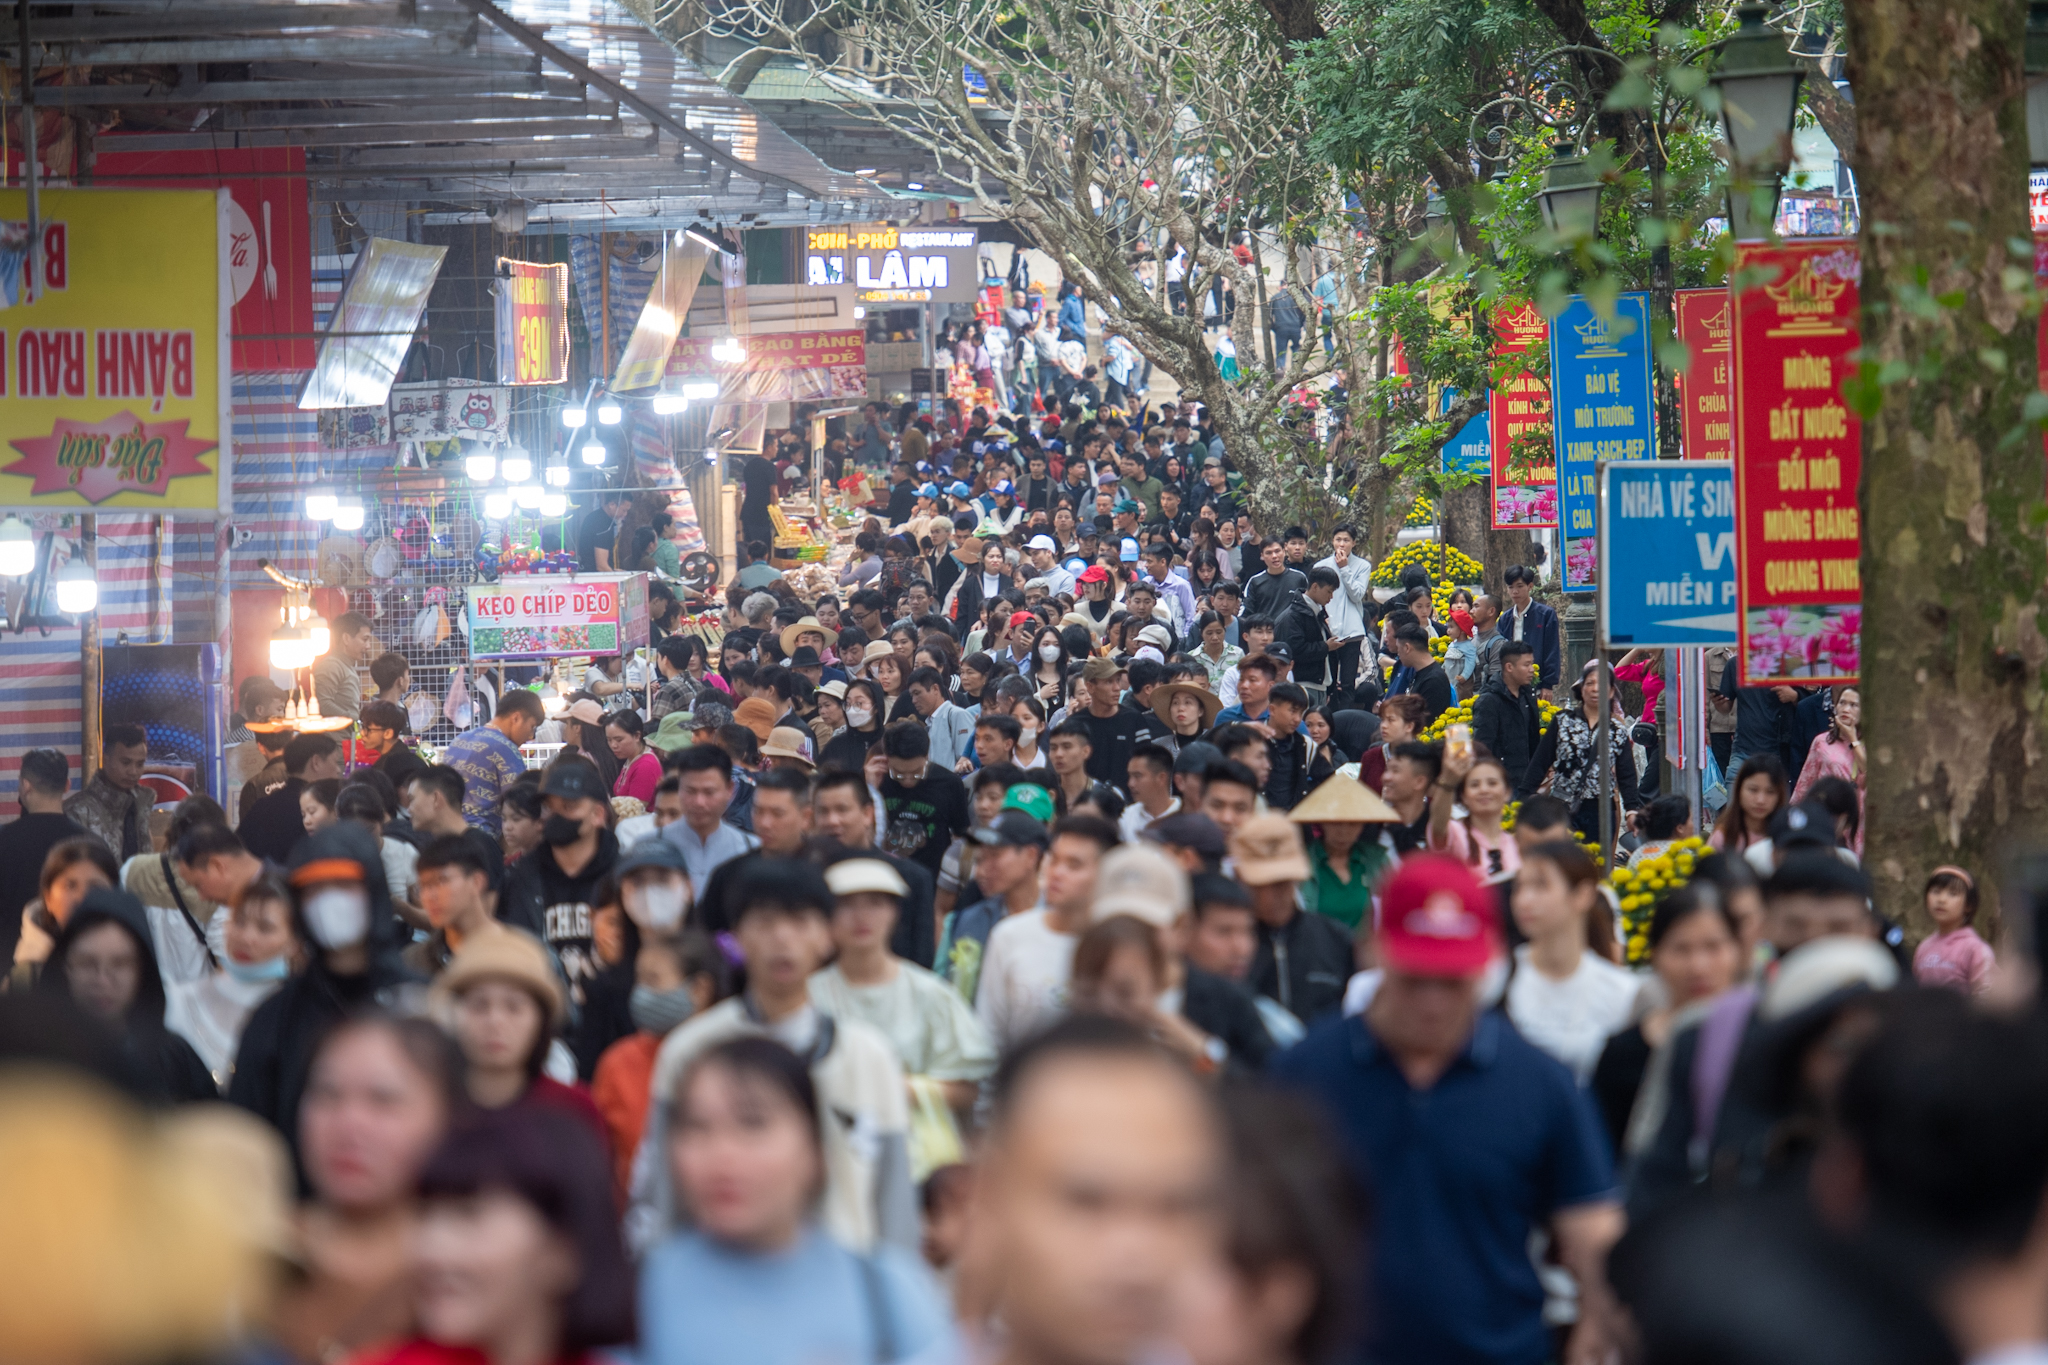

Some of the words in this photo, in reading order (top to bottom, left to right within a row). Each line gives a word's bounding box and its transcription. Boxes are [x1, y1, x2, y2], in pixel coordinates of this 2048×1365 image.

[900, 232, 975, 247] RESTAURANT
[856, 249, 948, 288] LÂM
[751, 338, 794, 352] CAO
[801, 333, 862, 349] BẰNG
[820, 349, 858, 365] DẺ
[18, 330, 85, 397] RAU
[96, 331, 193, 413] BÁNH
[1586, 365, 1605, 394] BẢO
[1608, 368, 1621, 397] VỆ
[1783, 349, 1832, 390] MỪNG
[1508, 398, 1528, 415] KÍNH
[1575, 404, 1594, 429] MÔI
[1596, 402, 1635, 427] TRƯỜNG
[1699, 392, 1727, 413] CHÙA
[1769, 397, 1800, 441] ĐẤT
[1803, 397, 1847, 440] NƯỚC
[1705, 420, 1730, 441] KÍNH
[57, 432, 106, 485] sản
[108, 426, 166, 485] Đặc
[1778, 446, 1806, 491] ĐỔI
[1809, 448, 1841, 490] MỚI
[1567, 471, 1580, 496] LÀ
[1621, 473, 1664, 519] NHÀ
[1670, 472, 1696, 527] VỆ
[1702, 480, 1734, 518] SIN
[1573, 501, 1593, 530] CỦA
[1763, 502, 1812, 542] MỪNG
[1814, 495, 1859, 541] ĐẢNG
[1645, 572, 1714, 606] MIỄN
[1765, 560, 1819, 596] QUANG
[1821, 559, 1860, 591] VINH
[477, 597, 515, 622] KẸO
[522, 588, 566, 615] CHÍP
[573, 586, 611, 613] DẺO
